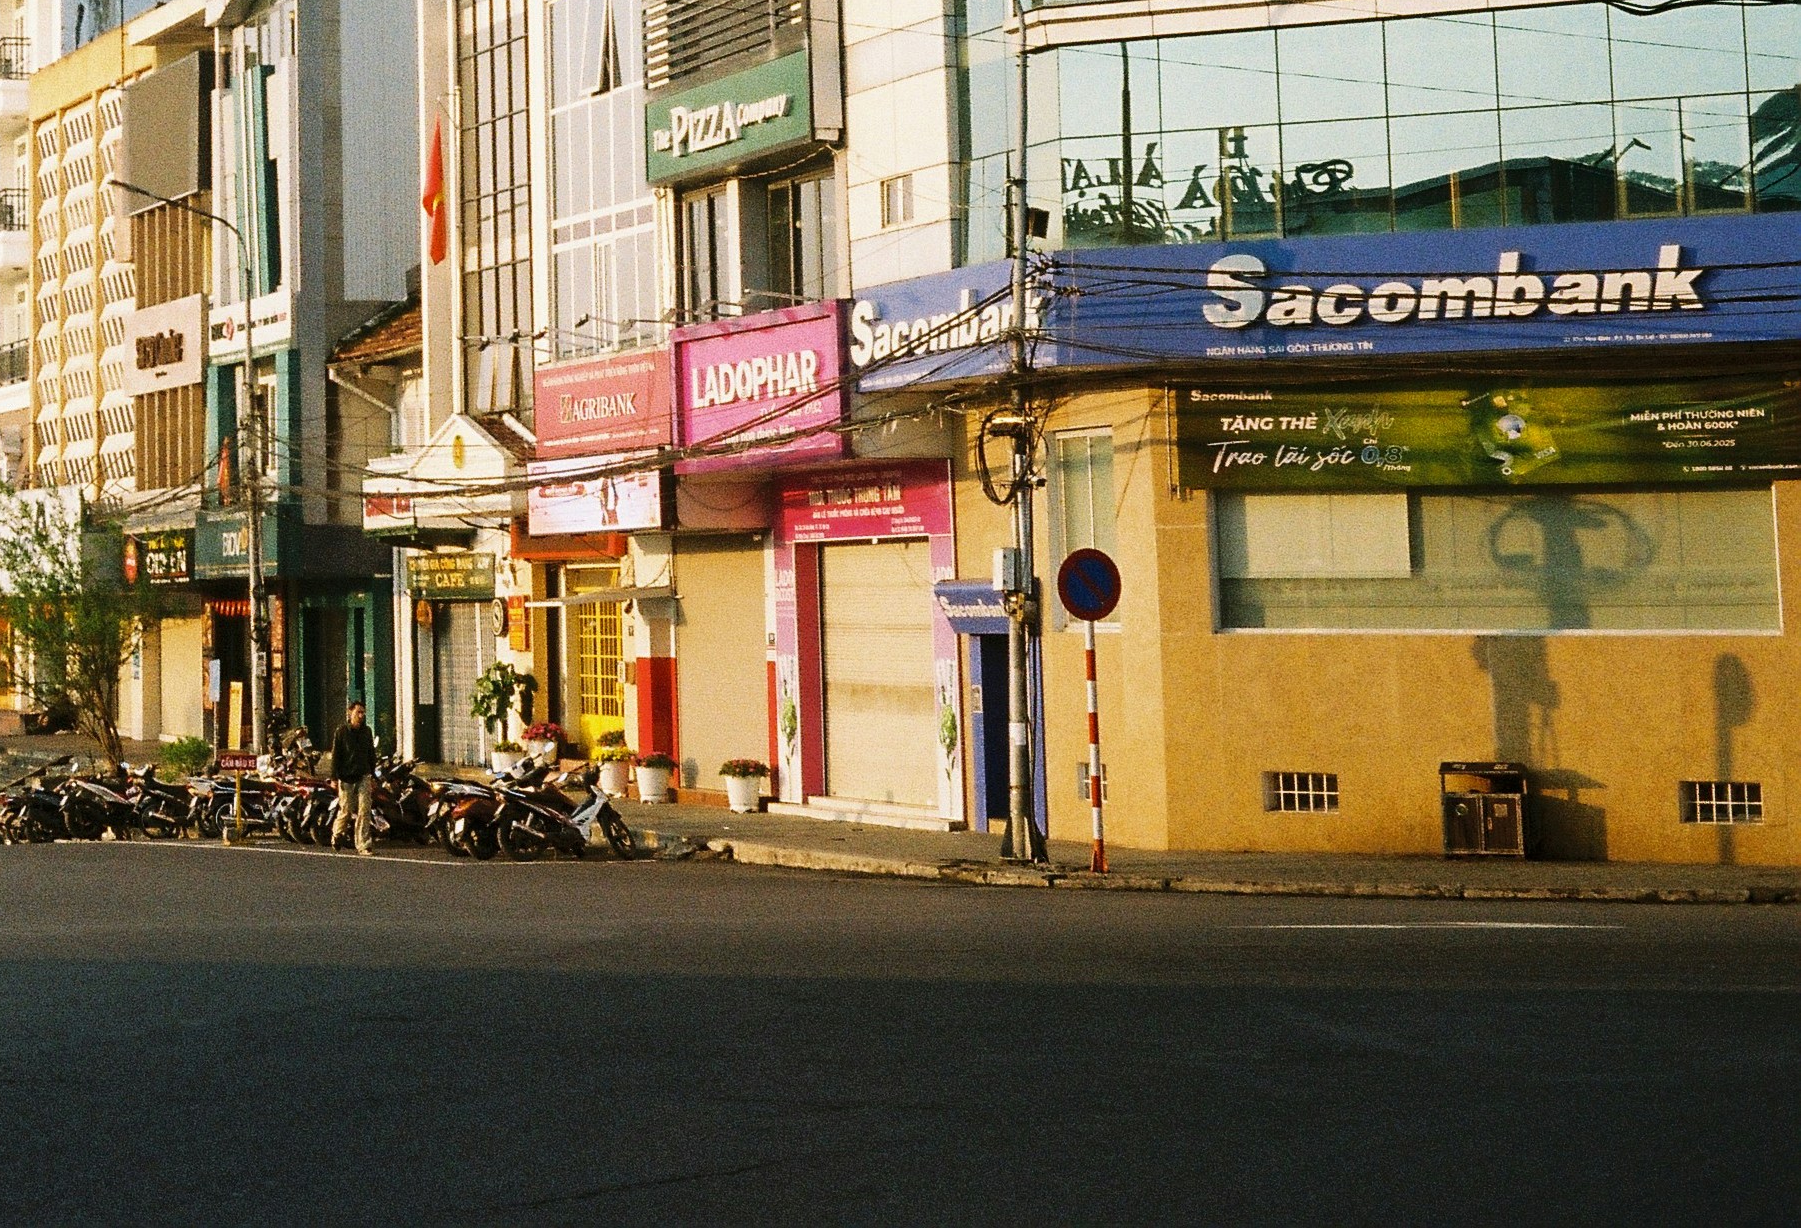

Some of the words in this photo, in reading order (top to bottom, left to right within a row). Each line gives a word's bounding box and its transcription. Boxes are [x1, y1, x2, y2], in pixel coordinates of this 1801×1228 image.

[670, 100, 741, 158] PIZZA
[1201, 244, 1704, 329] Sacombank
[850, 277, 1041, 367] Sacombank
[692, 349, 818, 409] LADOPHAR
[572, 392, 638, 422] AGRIBANK
[1190, 389, 1274, 402] Sacombank
[1220, 414, 1275, 435] TẶNG
[1278, 411, 1319, 431] THẺ
[1630, 409, 1660, 422] MIỄN
[1661, 409, 1683, 421] PHÍ
[1684, 409, 1735, 420] THƯỜNG
[1736, 407, 1766, 418] NIÊN
[1656, 422, 1666, 431] &
[1667, 420, 1702, 431] HOÀN
[1207, 440, 1268, 474] Trao
[1274, 444, 1311, 468] lãi
[1310, 445, 1357, 472] sốc
[1686, 439, 1736, 448] 30.06.2025
[854, 485, 881, 504] TRUNG
